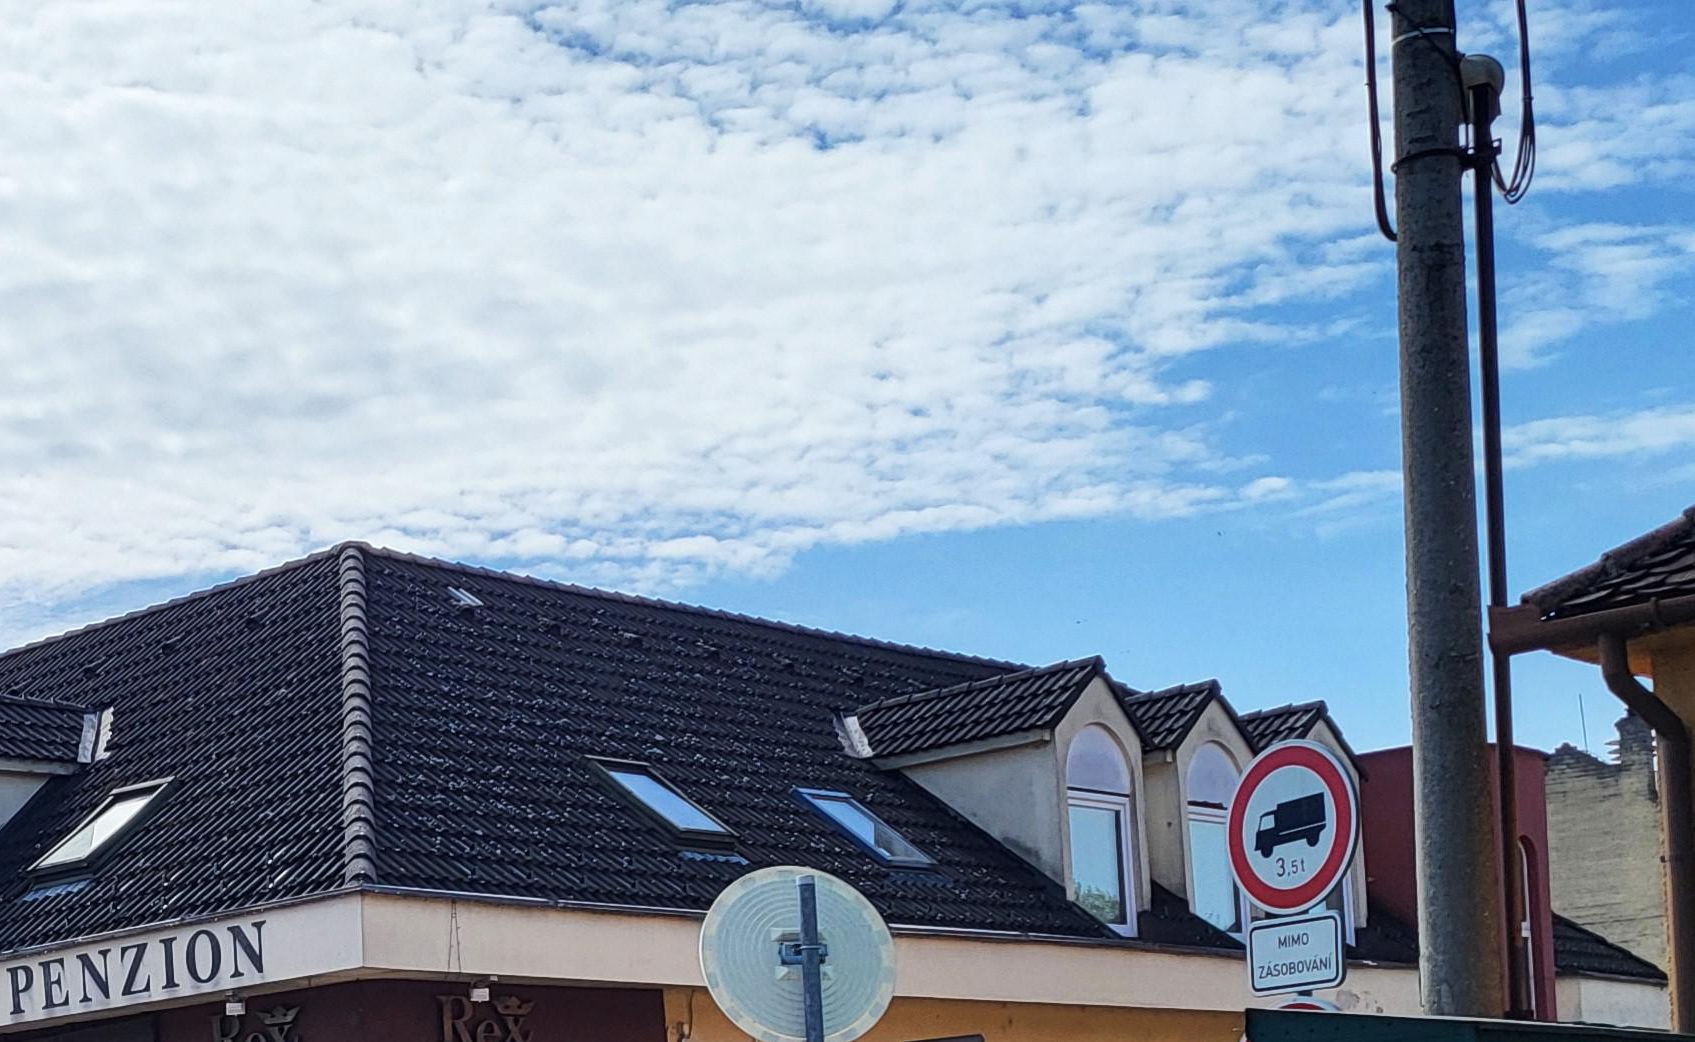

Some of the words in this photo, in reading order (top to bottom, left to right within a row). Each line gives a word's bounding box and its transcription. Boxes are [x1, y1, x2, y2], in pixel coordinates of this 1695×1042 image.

[1278, 932, 1310, 950] MIMO
[9, 920, 267, 1016] PENZION
[1258, 952, 1332, 980] ZÁSOBOVÁNÍ
